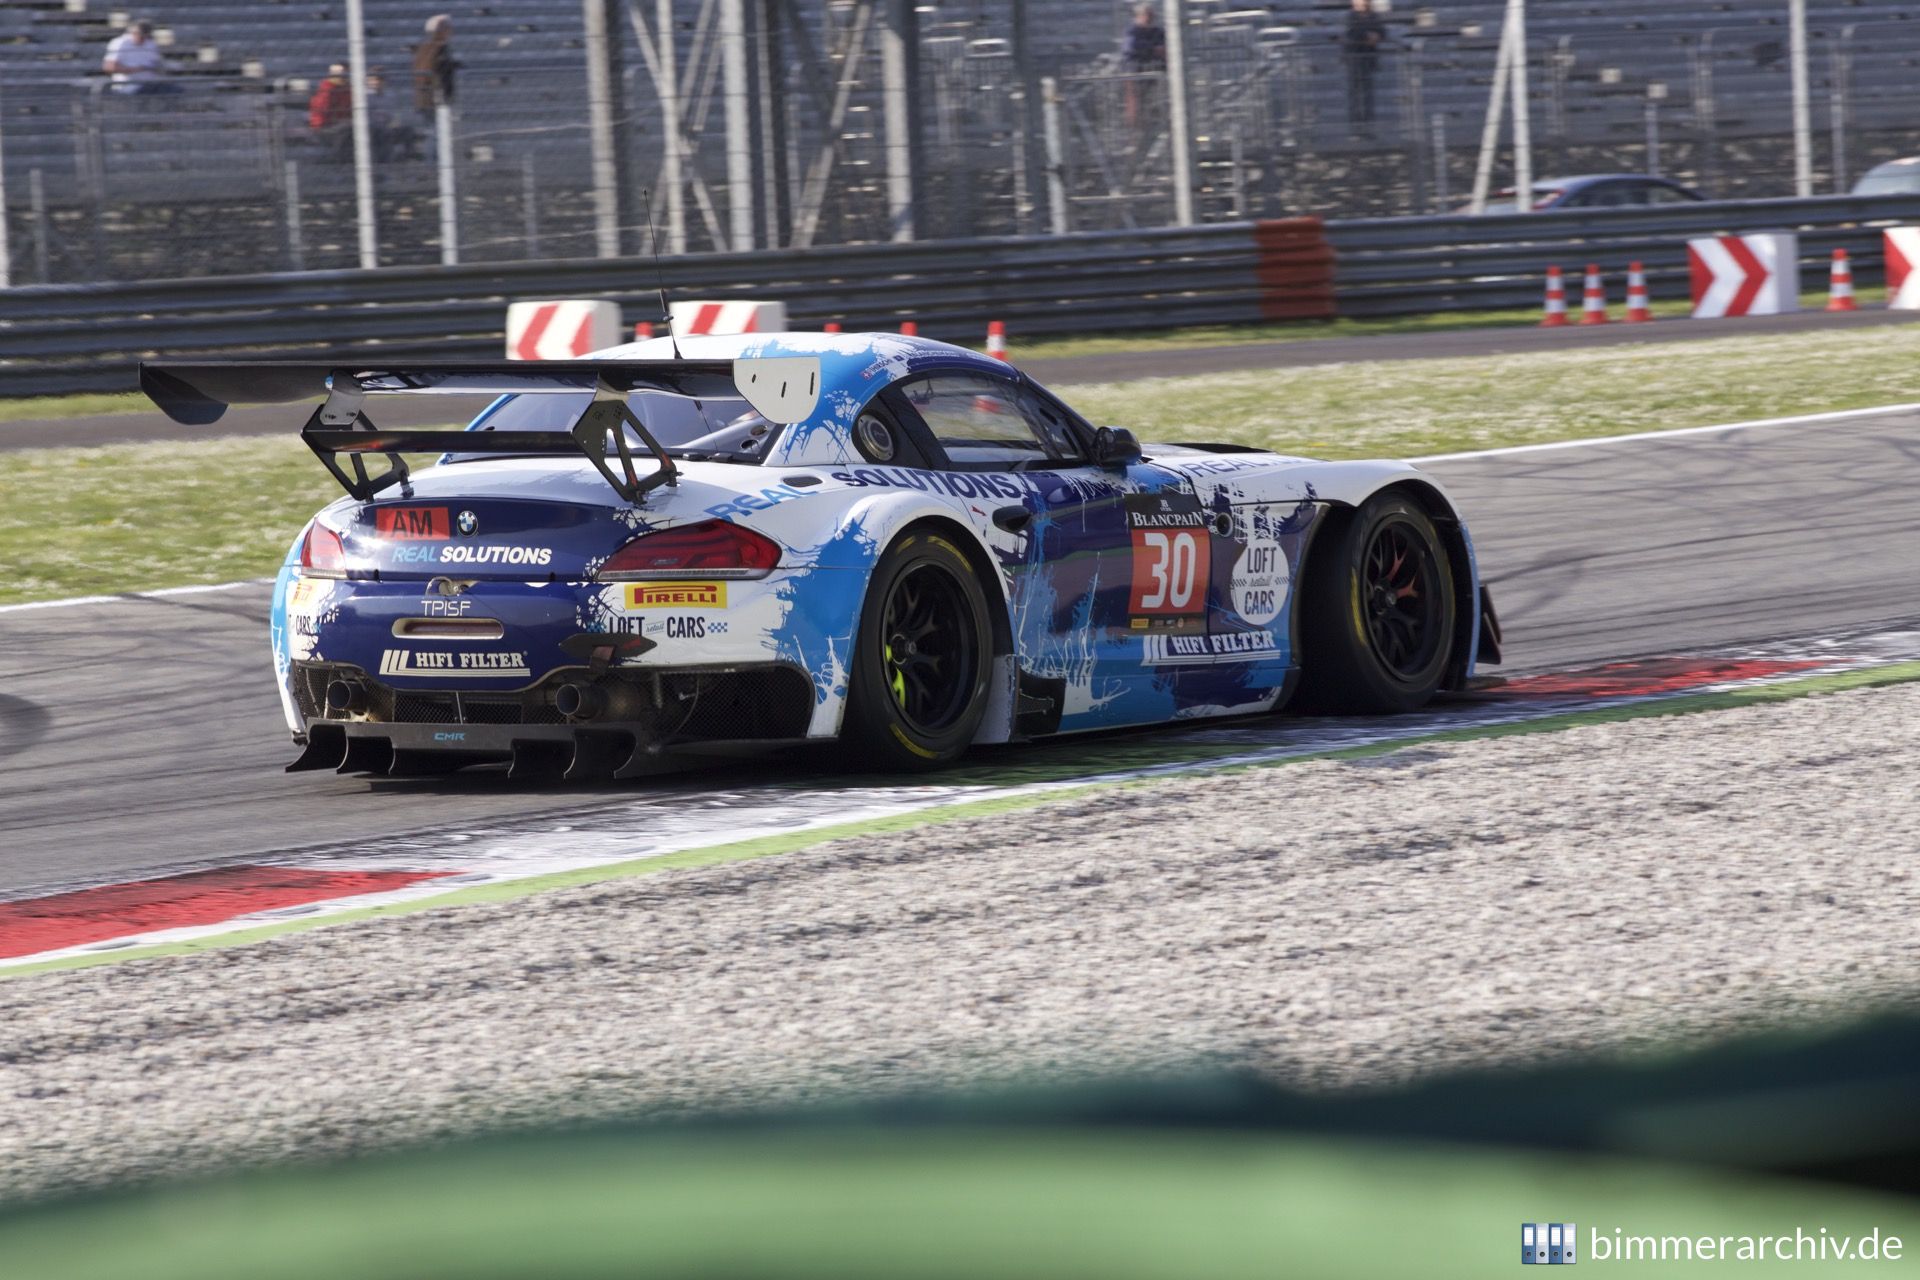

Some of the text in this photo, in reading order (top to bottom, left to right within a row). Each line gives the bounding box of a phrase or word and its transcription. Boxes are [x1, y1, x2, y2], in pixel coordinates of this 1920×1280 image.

[703, 467, 1022, 521] REAL SOLUTIONS
[391, 510, 433, 538] AM
[392, 546, 552, 565] REAL SOLUTIONS
[1247, 547, 1277, 574] LOFT
[1141, 532, 1196, 609] 30
[634, 585, 717, 604] PIRELLI
[1244, 590, 1275, 616] CARS
[421, 600, 471, 617] TPISF
[609, 616, 646, 638] LOFT
[667, 616, 706, 638] CARS
[1172, 630, 1277, 654] HIFI FILTER
[415, 652, 525, 668] HIFI FILTER
[434, 732, 466, 741] CMR
